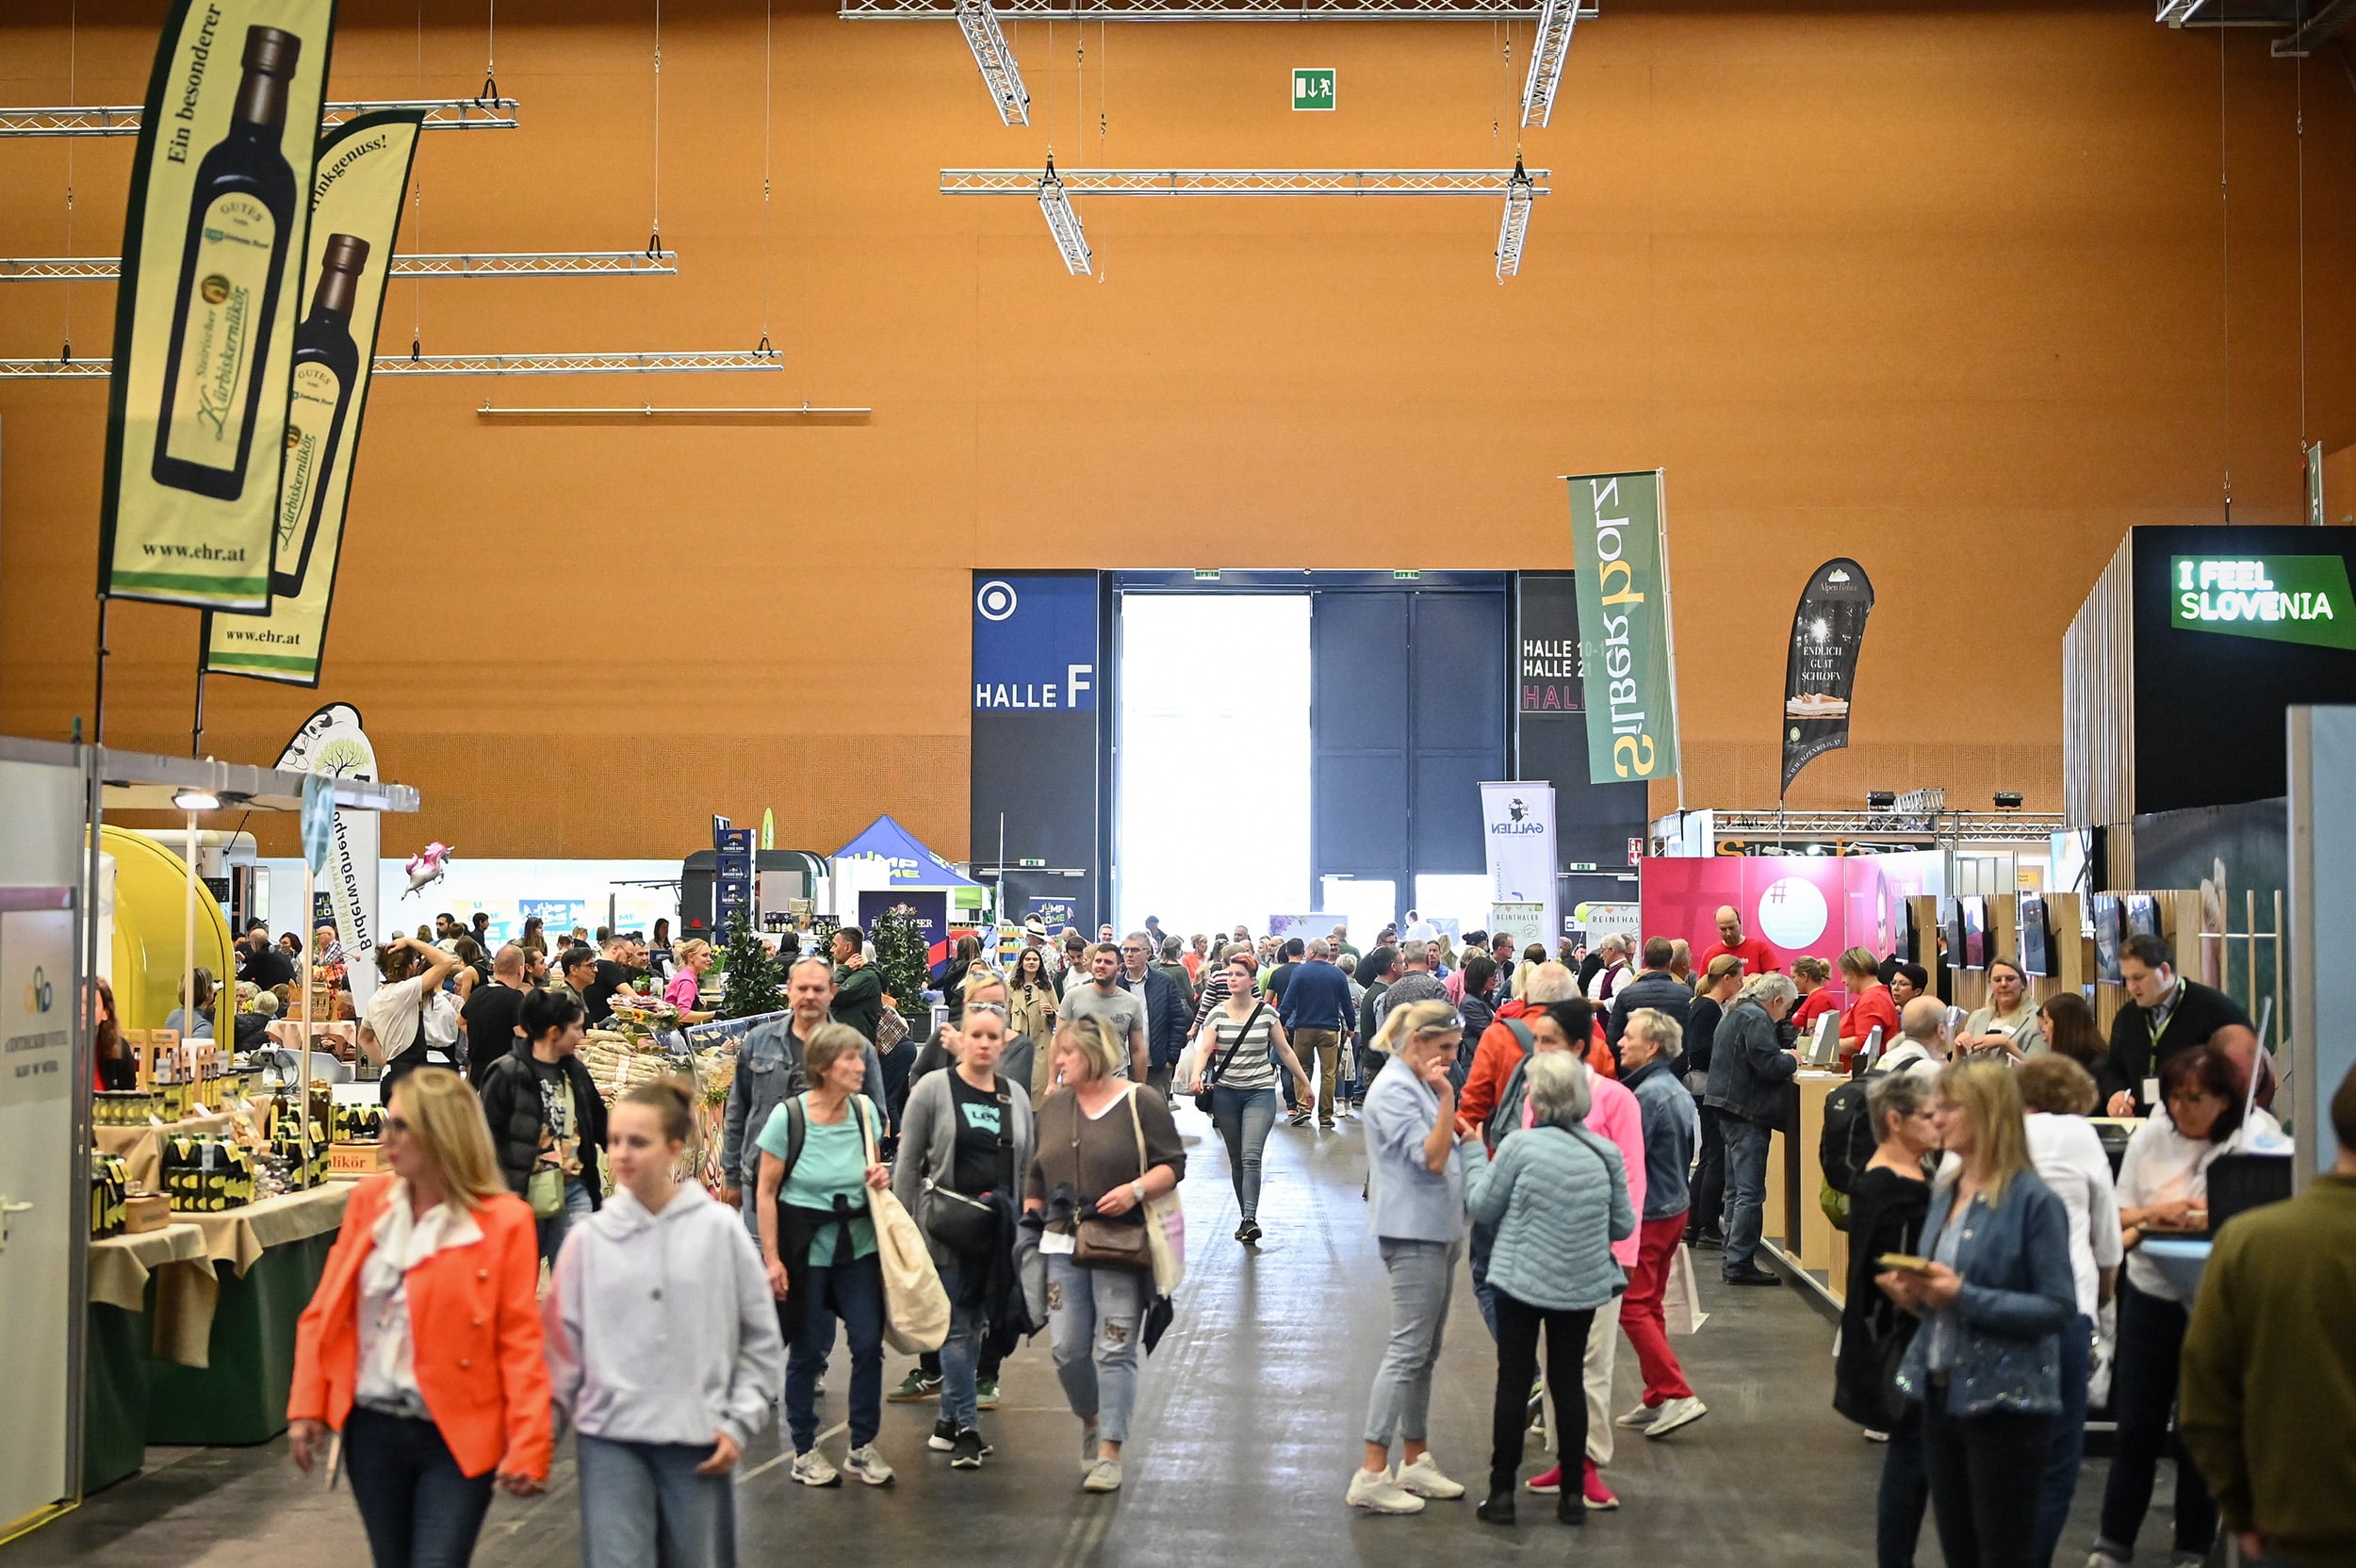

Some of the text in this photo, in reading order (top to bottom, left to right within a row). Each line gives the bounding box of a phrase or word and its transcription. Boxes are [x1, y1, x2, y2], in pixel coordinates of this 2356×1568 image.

[167, 3, 221, 165] Ein besonderer
[312, 134, 387, 213] rinkgenuss!
[220, 201, 263, 222] GUTES
[297, 368, 332, 385] GUTES
[142, 543, 246, 563] www.ehr.at
[2178, 560, 2274, 591] I FEEL
[2180, 591, 2335, 621] SLOVENIA
[225, 629, 301, 645] www.ehr.at
[1523, 640, 1572, 658] HALLE
[1803, 646, 1842, 657] ENDLICH
[1523, 660, 1572, 678] HALLE
[976, 664, 1093, 708] HALLE F
[1039, 902, 1065, 913] JUMP
